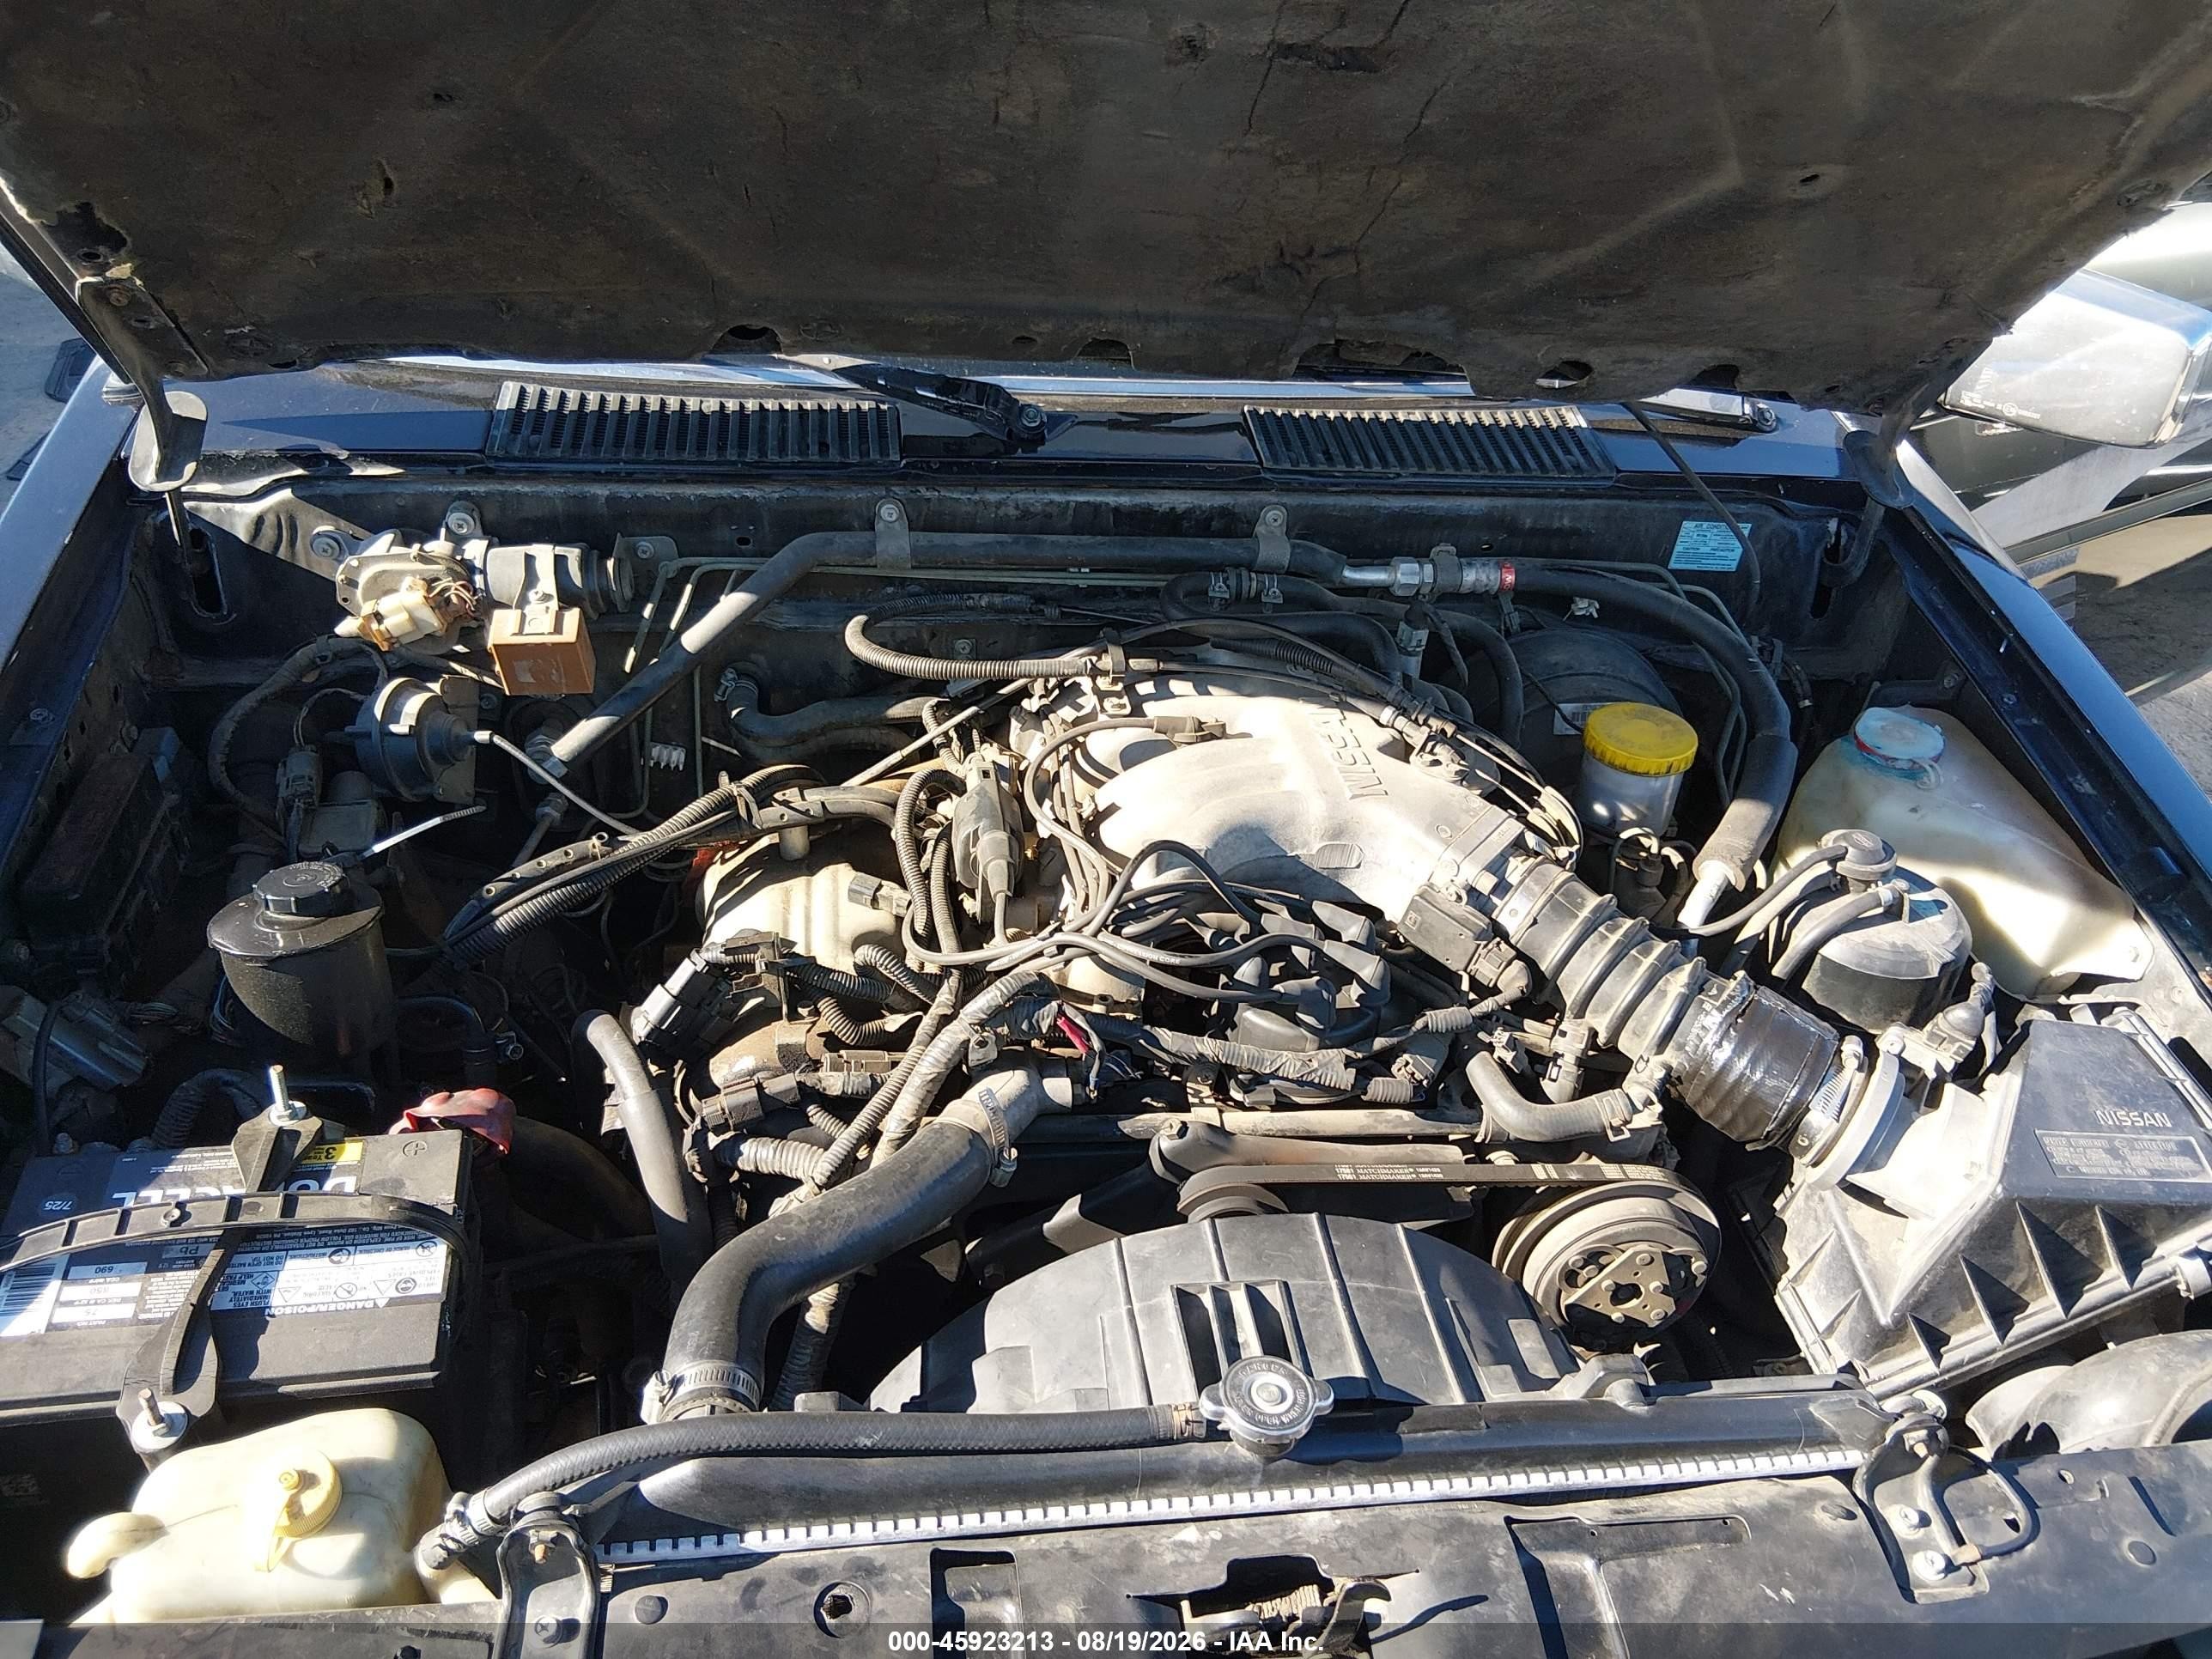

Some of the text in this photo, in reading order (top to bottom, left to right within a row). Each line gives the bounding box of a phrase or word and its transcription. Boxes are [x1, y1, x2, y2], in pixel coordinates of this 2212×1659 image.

[2094, 1109, 2172, 1127] NISSAN
[325, 1146, 337, 1160] 3
[43, 1200, 73, 1211] 7/25
[179, 1245, 200, 1255] Pb
[94, 1266, 114, 1274] 690
[228, 1294, 270, 1303] IMMEDIATELY
[264, 1299, 374, 1316] DANGER/POISON
